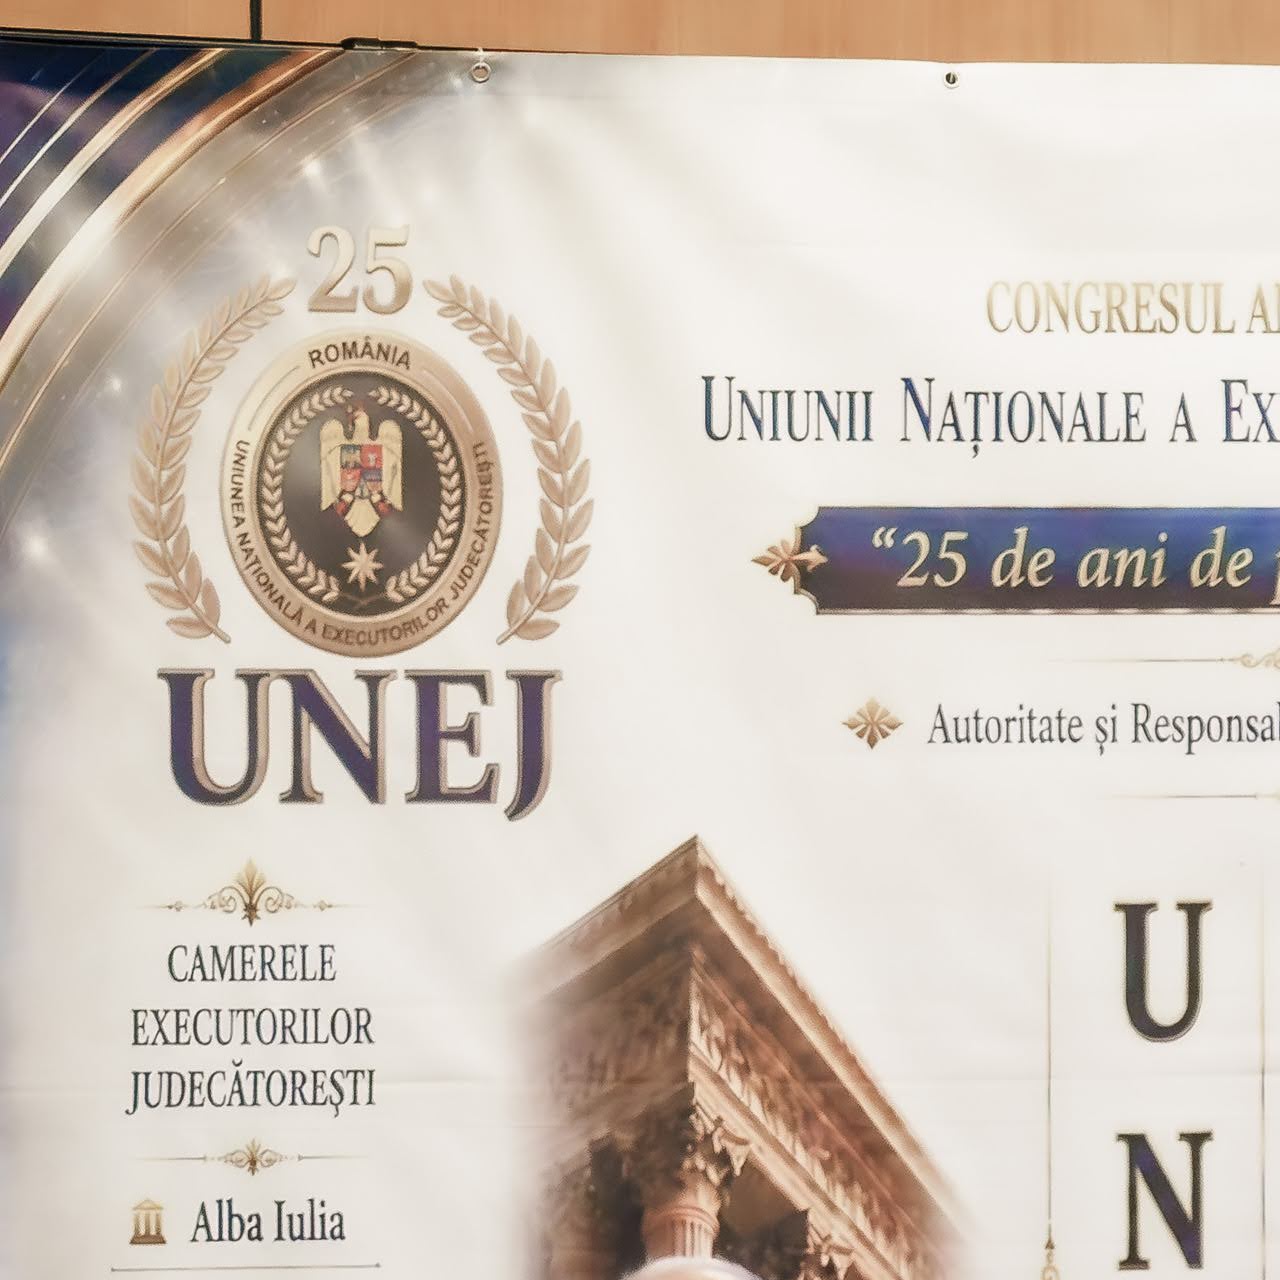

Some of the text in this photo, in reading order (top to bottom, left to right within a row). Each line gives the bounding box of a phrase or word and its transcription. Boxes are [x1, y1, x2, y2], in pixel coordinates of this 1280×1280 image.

[307, 224, 413, 316] 25
[987, 279, 1236, 335] CONGRESUL
[308, 336, 413, 370] ROMÂNIA
[702, 376, 874, 443] UNIUNII
[900, 377, 1147, 458] NAȚIONALE
[1169, 392, 1198, 443] A
[230, 440, 251, 529] UNIUNEA
[304, 617, 317, 635] A
[321, 598, 450, 647] EXECUTORILOR
[871, 526, 969, 588] “25
[991, 525, 1056, 588] de
[1077, 531, 1168, 588] ani
[1188, 525, 1254, 588] de
[157, 668, 563, 822] UNEJ
[927, 703, 1083, 744] Autoritate
[1095, 703, 1118, 756] și
[168, 943, 337, 983] CAMERELE
[131, 1007, 375, 1046] EXECUTORILOR
[125, 1059, 376, 1118] JUDECĂTOREȘTI
[190, 1197, 346, 1243] Alba Iulia
